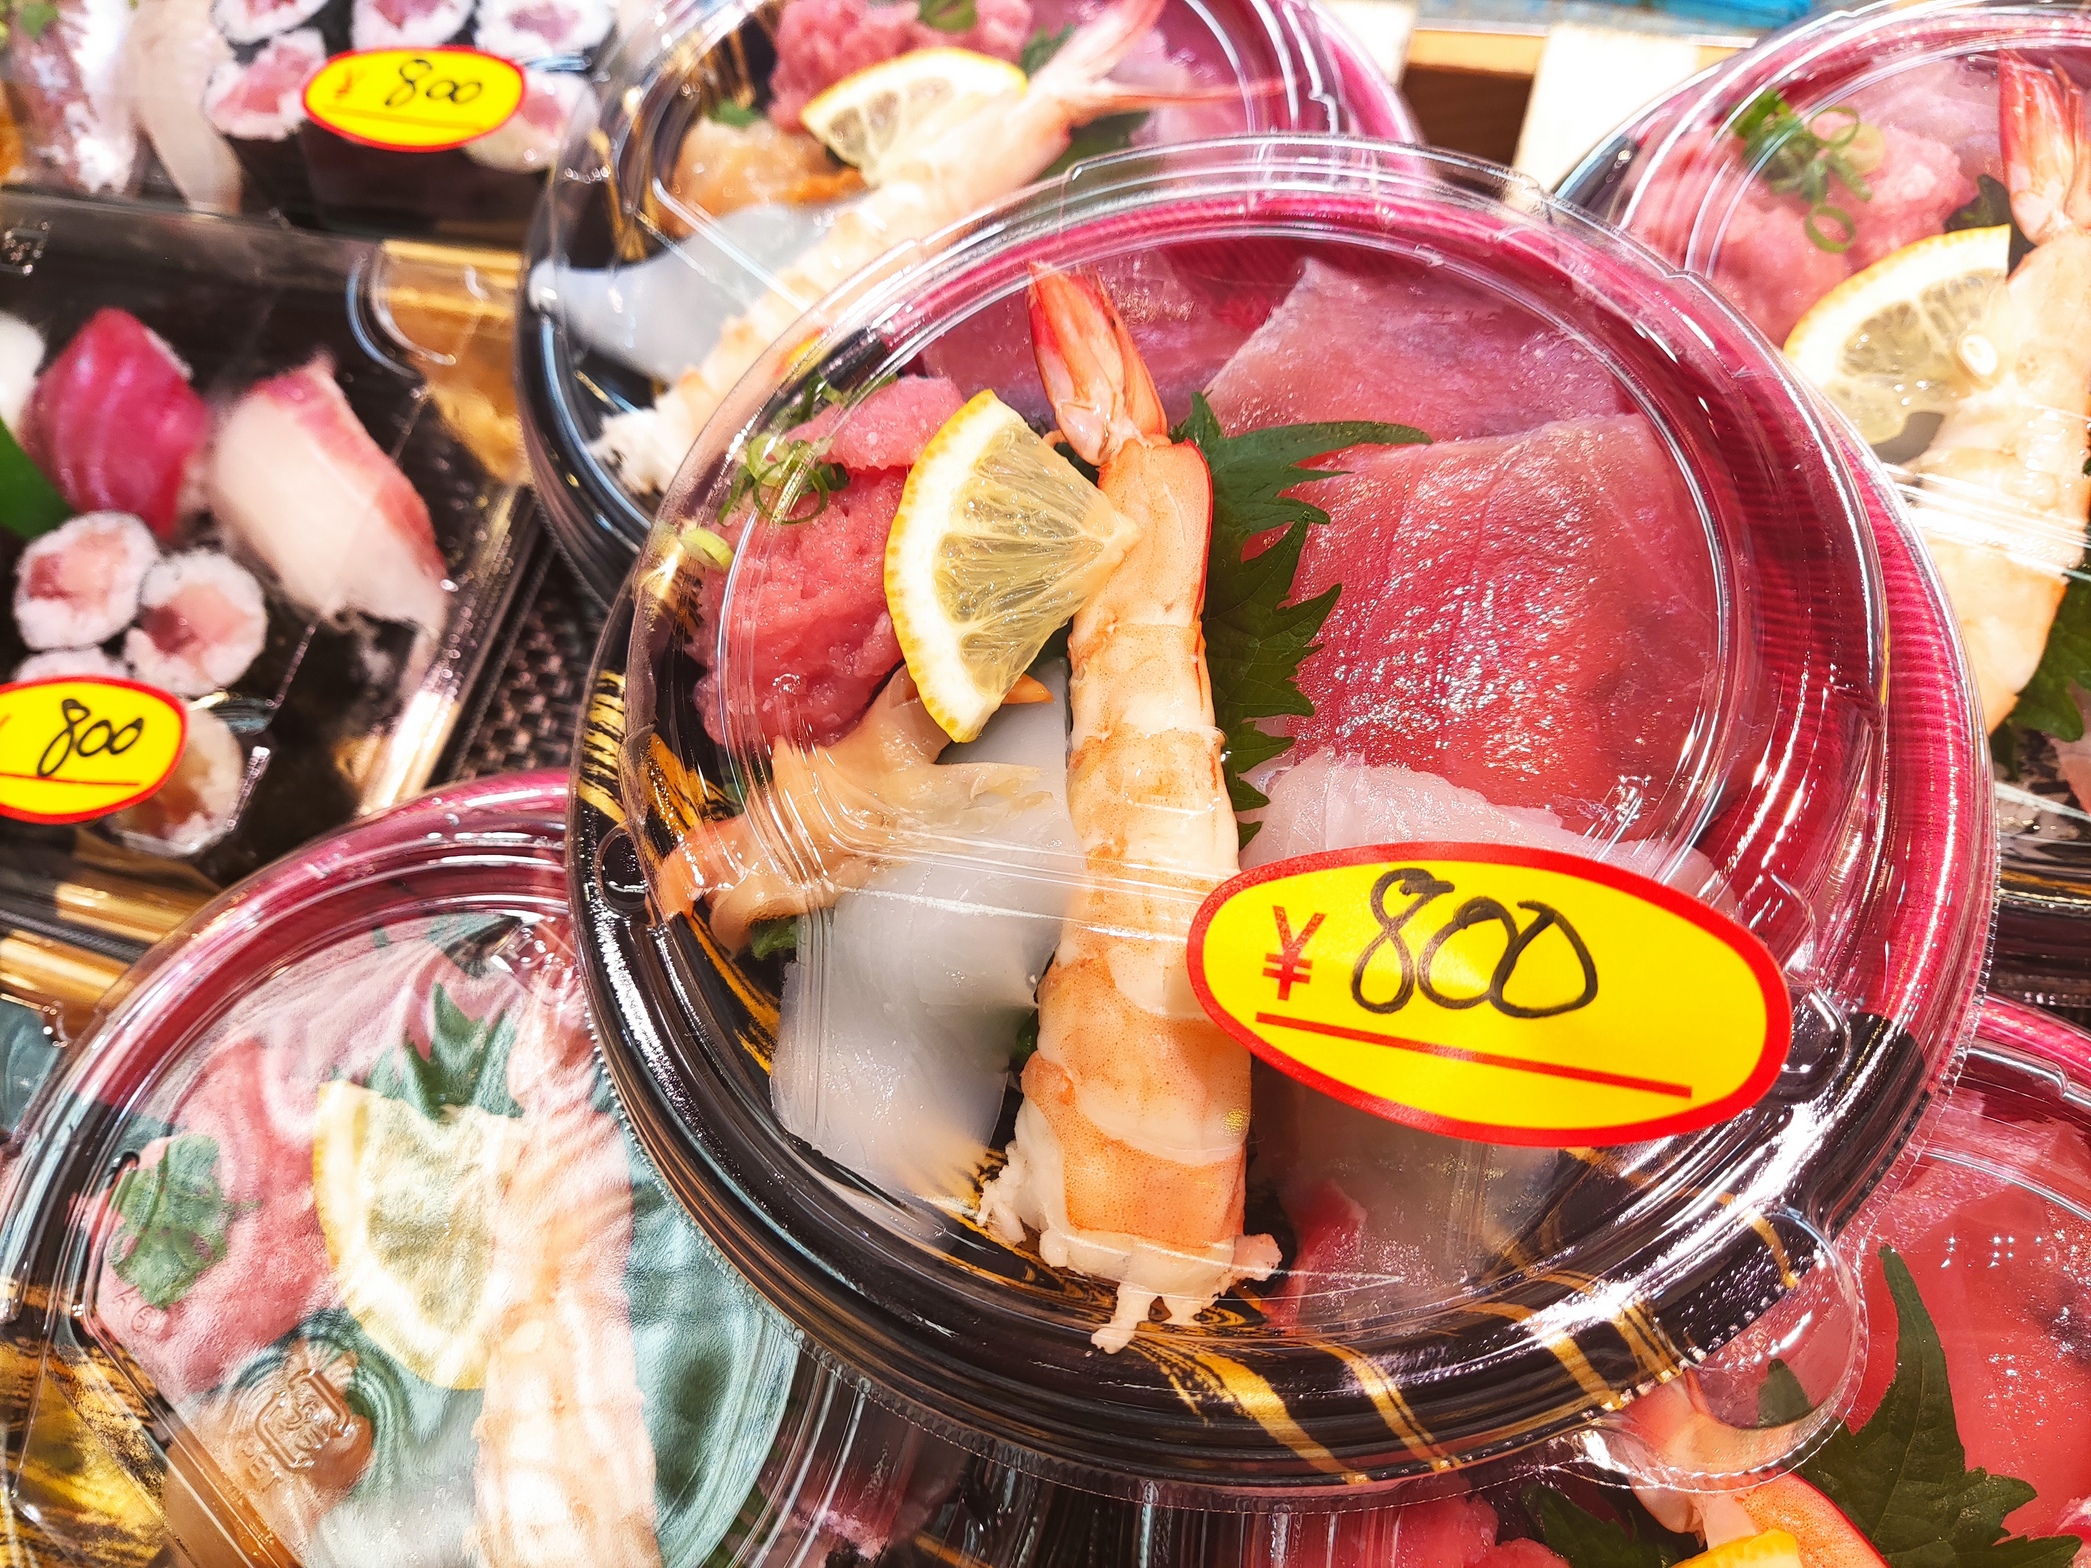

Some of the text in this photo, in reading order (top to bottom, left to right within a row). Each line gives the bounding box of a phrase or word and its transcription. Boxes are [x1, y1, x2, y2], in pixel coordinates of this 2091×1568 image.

[384, 58, 482, 107] 800
[37, 698, 144, 777] 800
[1350, 867, 1599, 1018] 800
